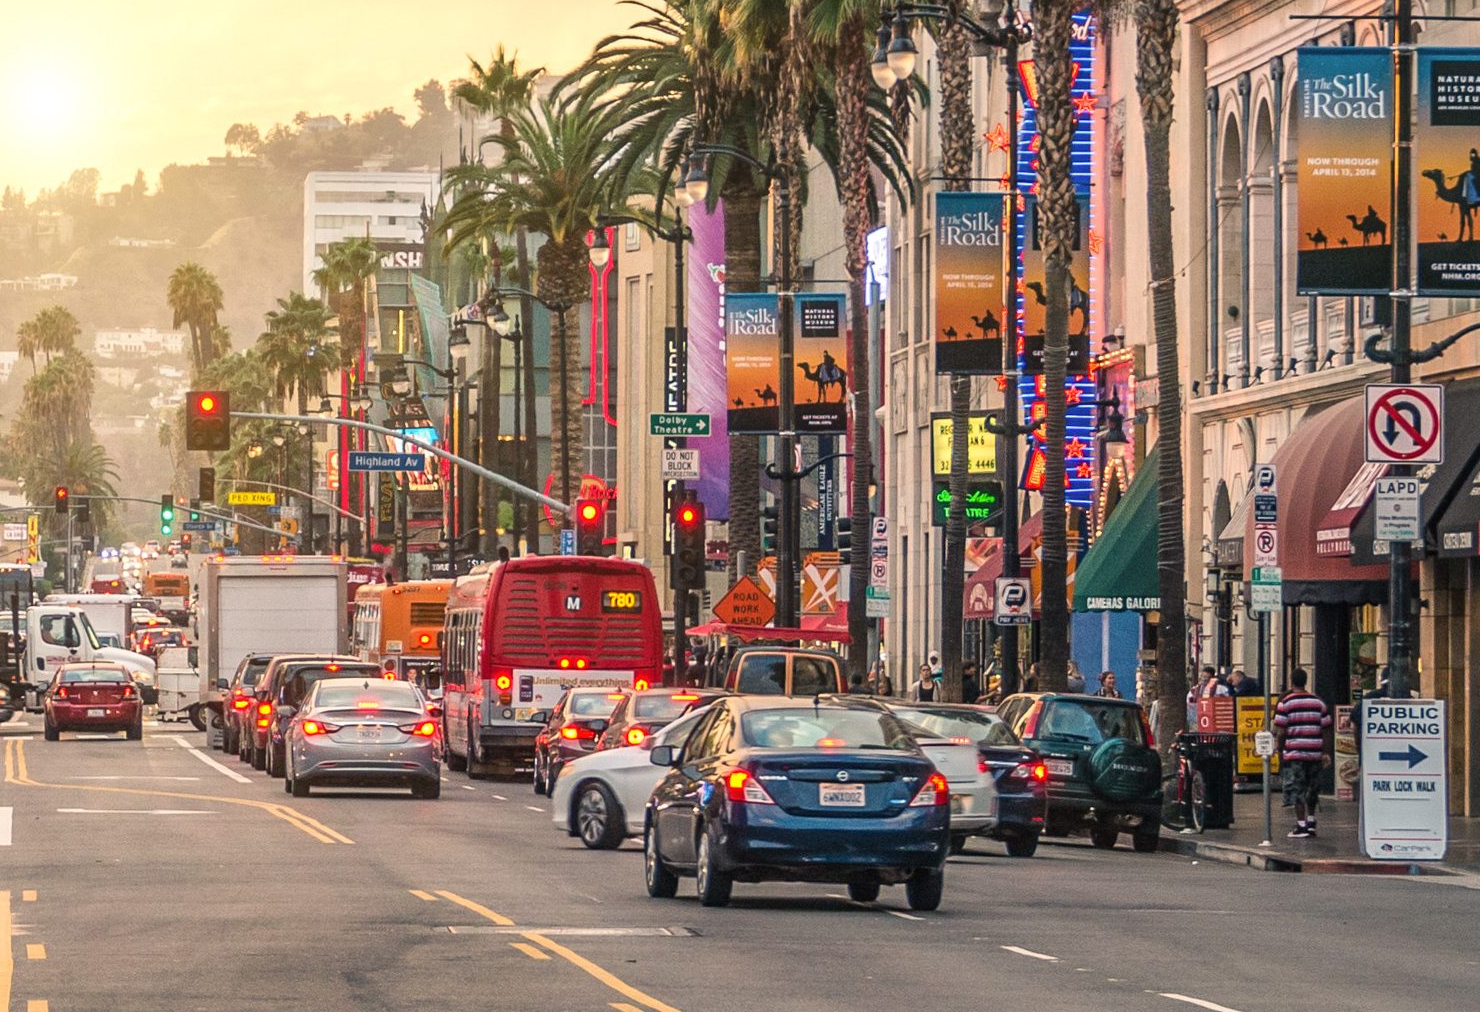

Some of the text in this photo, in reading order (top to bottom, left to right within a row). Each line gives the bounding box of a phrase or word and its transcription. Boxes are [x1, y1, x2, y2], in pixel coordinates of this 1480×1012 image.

[1313, 73, 1377, 99] The Silk
[1313, 91, 1386, 119] Road
[1307, 157, 1379, 167] NOW THROUGH
[1312, 168, 1340, 177] APRIL
[1355, 169, 1377, 177] 2014
[961, 211, 994, 231] Silk
[947, 225, 999, 246] Road
[1431, 263, 1447, 271] GET
[745, 308, 772, 324] Silk
[734, 318, 777, 335] Road
[659, 415, 687, 425] Dolby
[654, 425, 693, 434] Theatre
[355, 455, 418, 468] Highland Av
[666, 451, 694, 461] DO NOT
[667, 461, 692, 471] BLOCK
[976, 459, 995, 468] 4446
[1377, 482, 1417, 494] LAPD
[231, 494, 272, 503] PED XING
[943, 508, 989, 518] TATRE
[608, 592, 635, 607] 780
[733, 592, 759, 600] ROAD
[567, 597, 581, 610] M
[1086, 596, 1123, 609] CAMERAS
[733, 604, 759, 613] WORK
[731, 616, 762, 626] AHEAD
[533, 675, 578, 686] Unlimited
[1367, 706, 1438, 720] PUBLIC
[1245, 717, 1266, 728] STA
[1367, 722, 1439, 736] PARKING
[1372, 780, 1436, 793] PARK LOCK WALK
